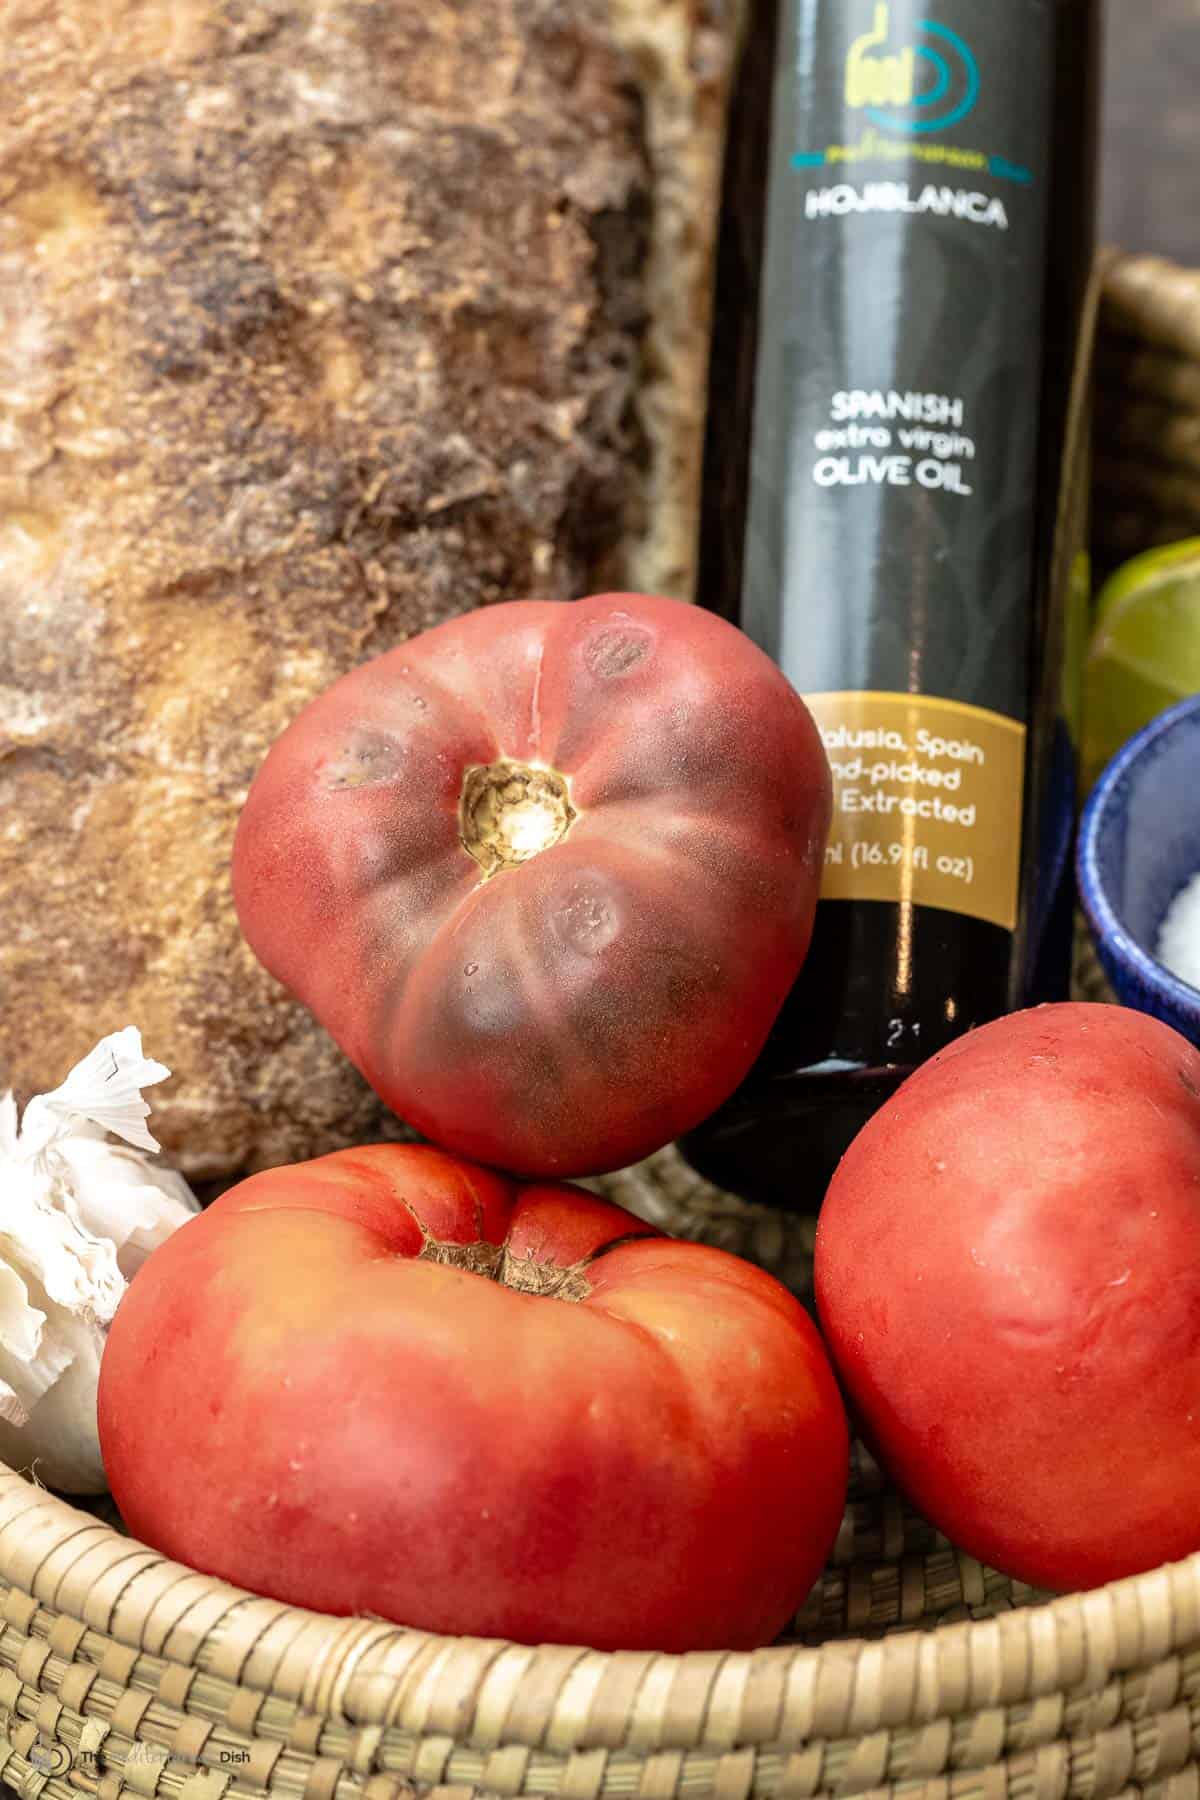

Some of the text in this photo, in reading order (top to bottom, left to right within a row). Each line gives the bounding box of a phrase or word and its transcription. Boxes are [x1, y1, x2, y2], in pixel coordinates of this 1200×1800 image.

[831, 390, 964, 427] SPANISH
[814, 422, 976, 460] extra virgin
[813, 455, 974, 496] OLIVE OIL
[915, 729, 985, 766] Spain
[840, 787, 977, 827] Extracted
[936, 855, 975, 884] oz)
